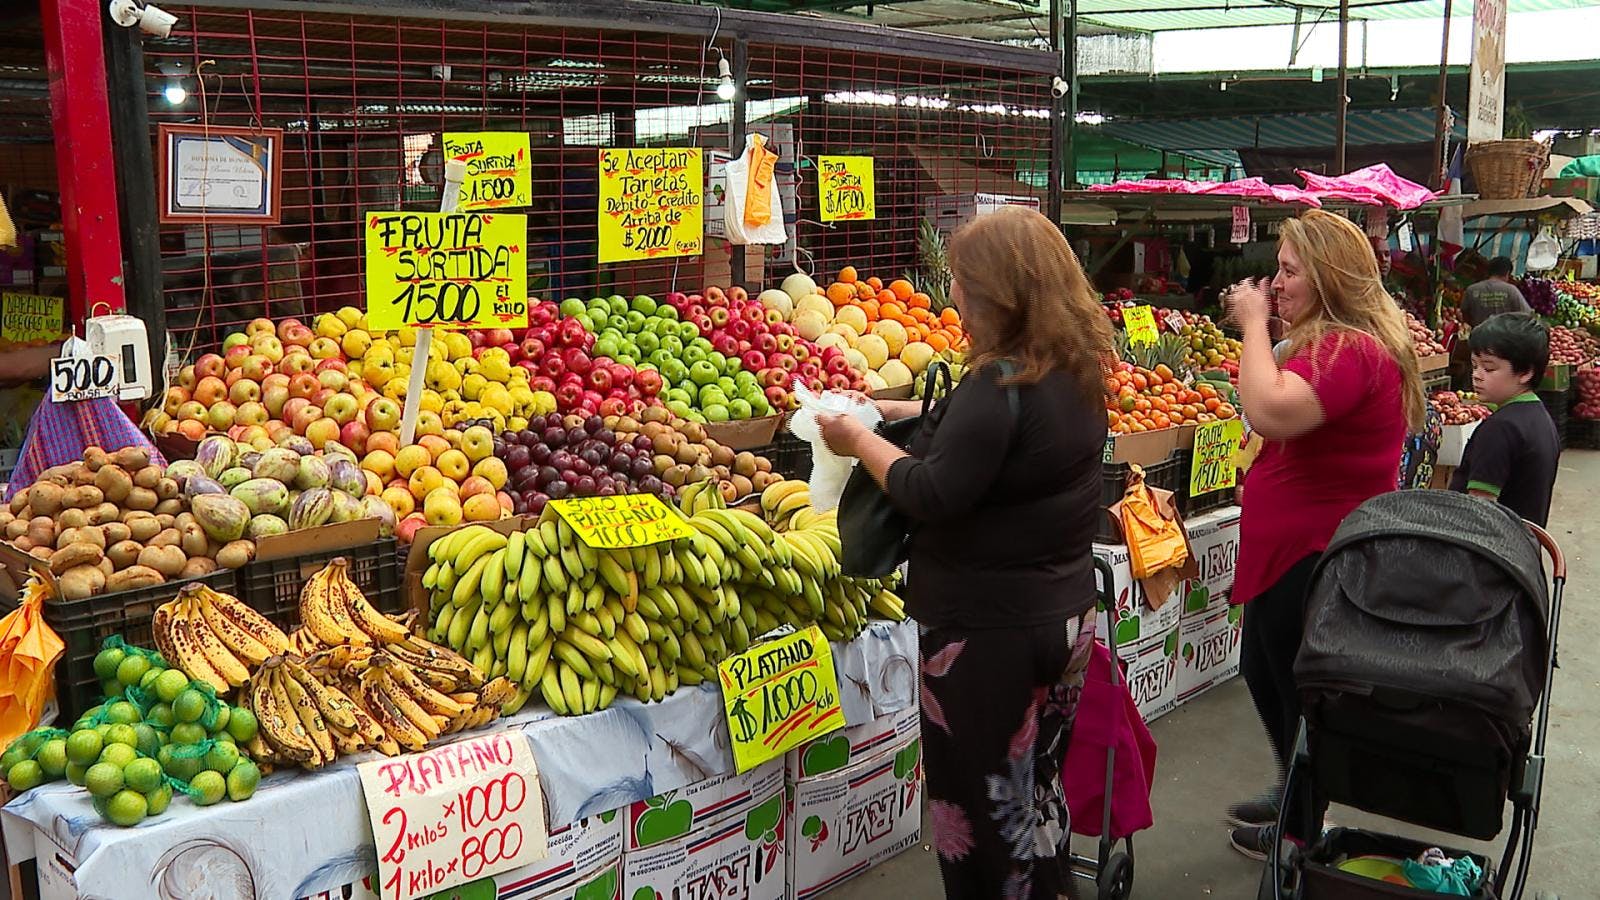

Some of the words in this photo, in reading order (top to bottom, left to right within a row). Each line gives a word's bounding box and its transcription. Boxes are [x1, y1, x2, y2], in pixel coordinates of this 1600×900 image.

[444, 140, 484, 158] FRUTA
[619, 171, 688, 199] Tarjetas
[621, 211, 661, 227] Arriba
[665, 208, 682, 222] de
[392, 282, 481, 323] 1500
[54, 356, 114, 393] 500
[65, 388, 101, 400] BOLSA
[1194, 461, 1220, 493] 1500
[566, 497, 617, 512] SOLO
[568, 506, 667, 527] PLATANO
[589, 525, 647, 546] 1000
[1207, 540, 1234, 579] RM
[1200, 631, 1228, 672] RM
[377, 734, 513, 797] PLATANO
[686, 787, 698, 796] Una
[699, 778, 721, 791] calidad
[381, 806, 407, 864] 2
[407, 821, 448, 850] Kilos
[457, 772, 526, 833] 1000
[842, 790, 897, 856] RM
[547, 834, 574, 849] lección
[385, 867, 402, 900] 1
[461, 822, 523, 878] 800
